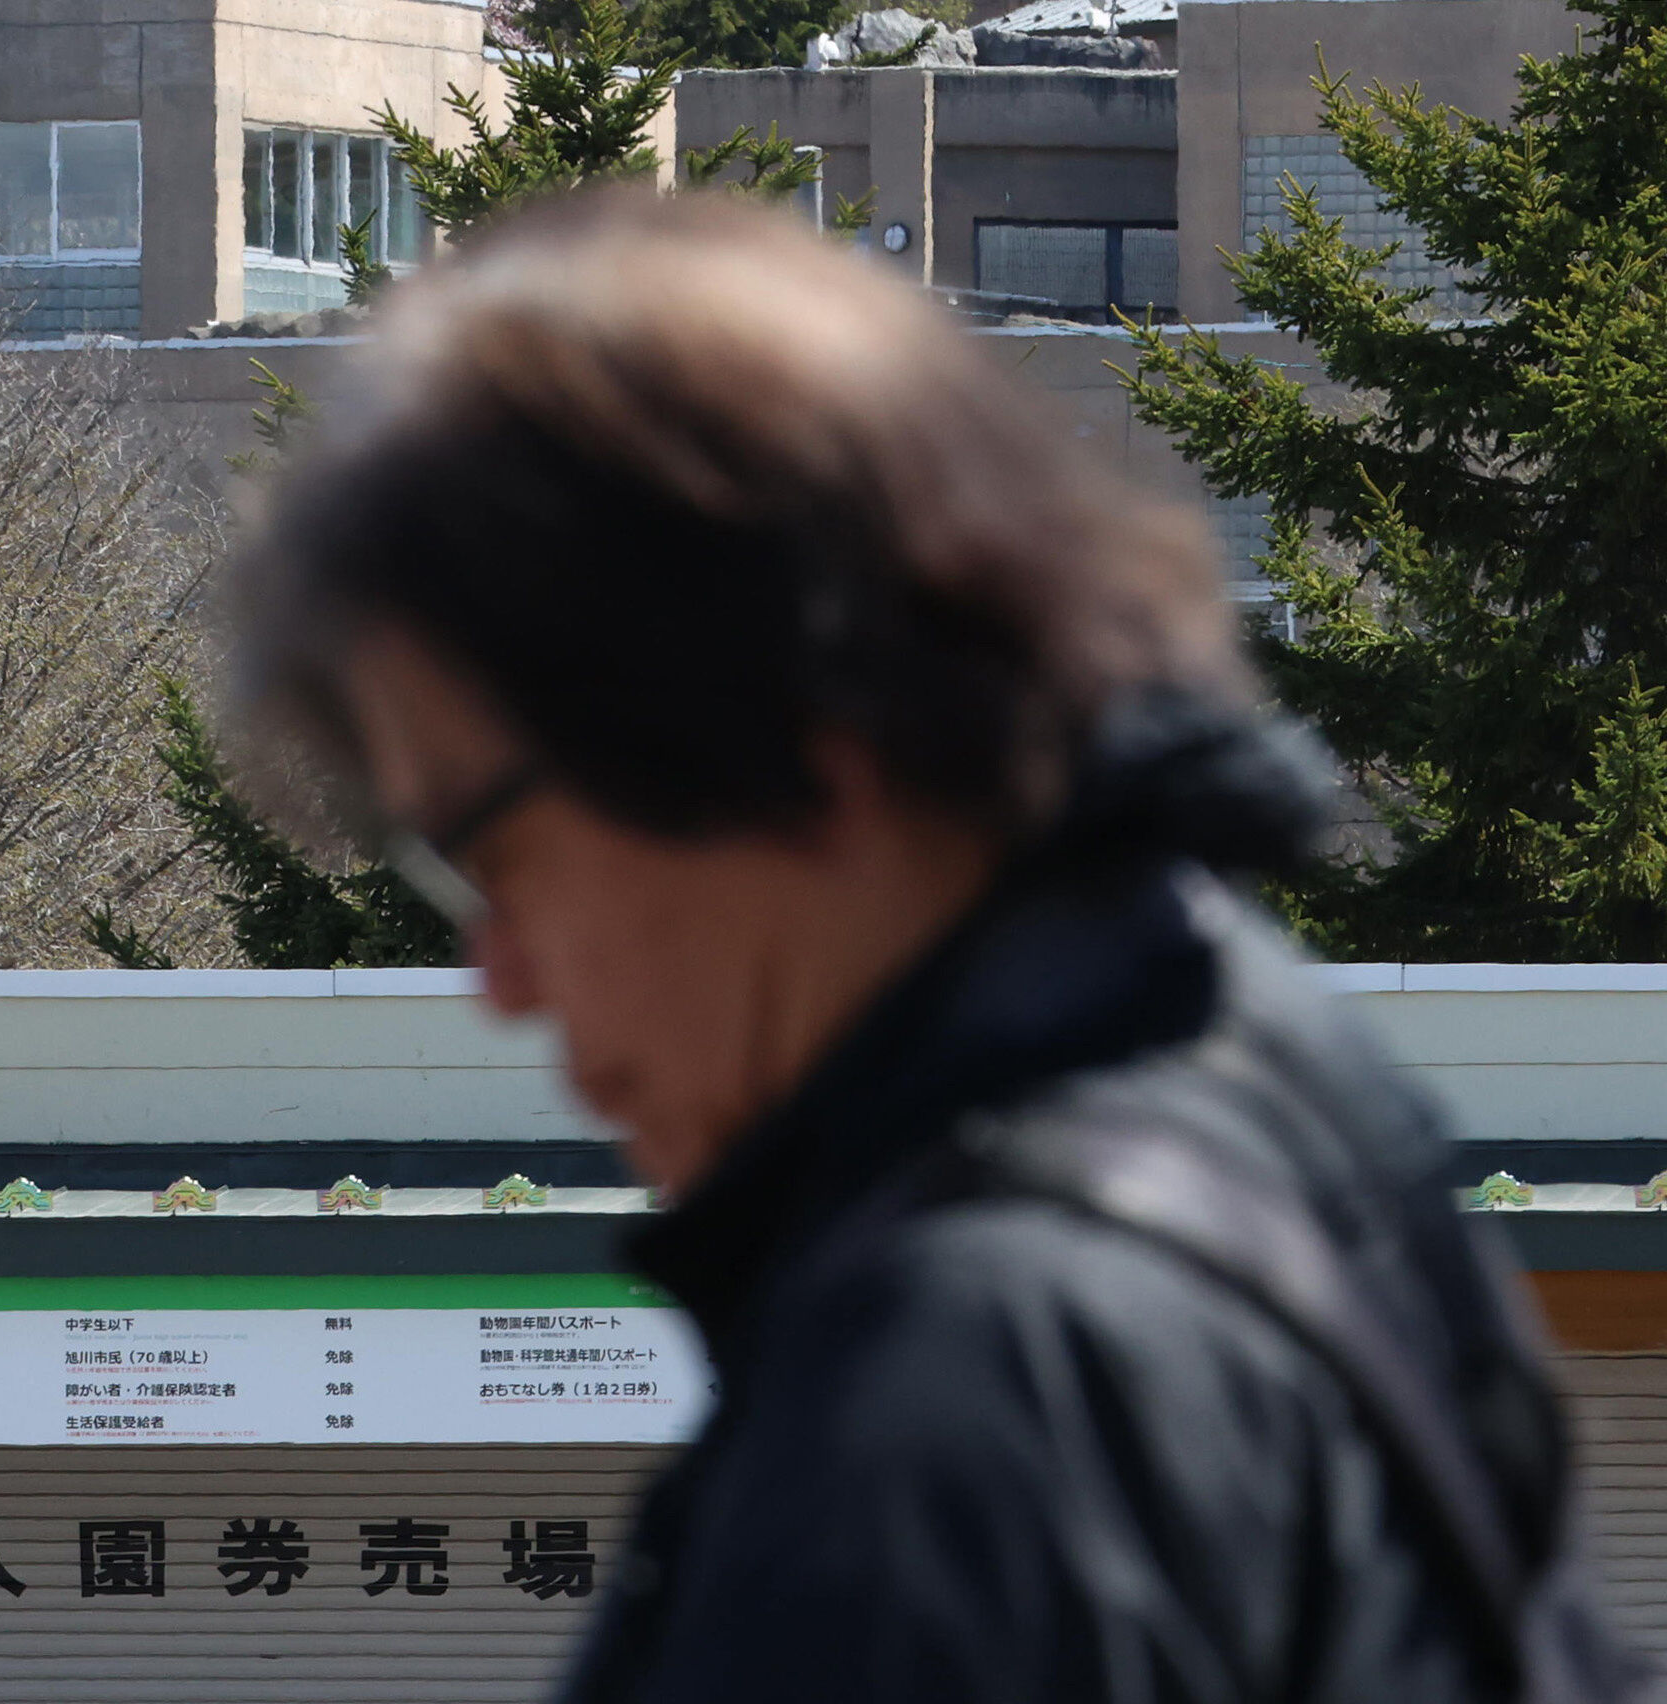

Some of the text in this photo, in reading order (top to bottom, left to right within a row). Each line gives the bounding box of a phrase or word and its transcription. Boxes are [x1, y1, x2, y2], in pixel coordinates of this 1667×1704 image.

[65, 1317, 353, 1331] 中学生以下 無料
[479, 1315, 622, 1330] 動物園年間パスポート
[324, 1350, 354, 1364] 免除
[324, 1382, 354, 1396] 免除
[66, 1415, 354, 1429] 生活保護受給者 免除
